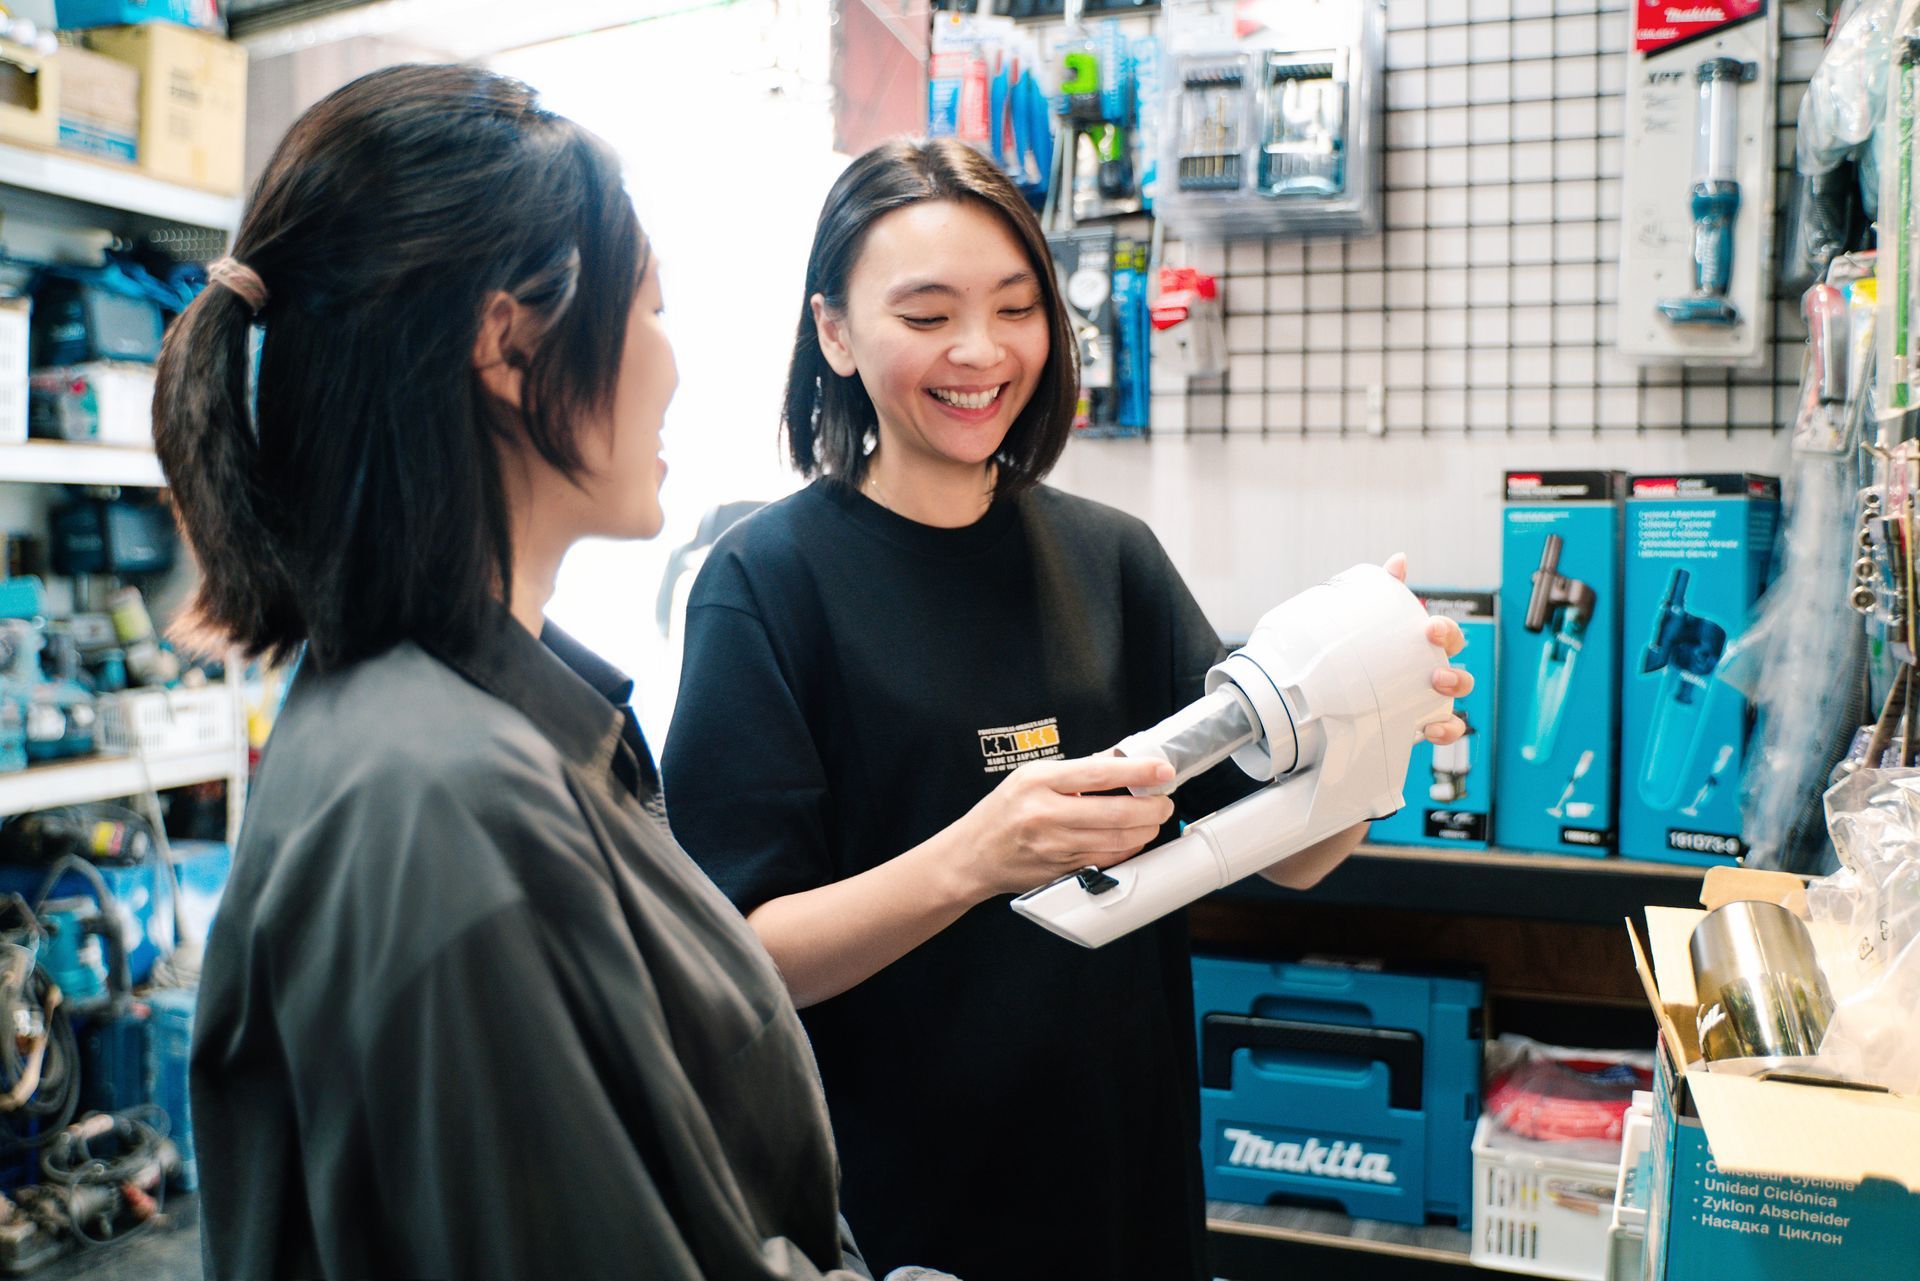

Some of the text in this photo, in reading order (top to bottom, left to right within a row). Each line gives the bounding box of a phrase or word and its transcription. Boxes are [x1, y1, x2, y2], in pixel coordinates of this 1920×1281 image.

[986, 756, 1006, 766] MADE
[1006, 755, 1016, 763] IN
[1016, 751, 1040, 762] JAPAN
[1040, 746, 1059, 757] 1997
[1704, 1178, 1838, 1208] Unidad Ciclónica
[1702, 1196, 1851, 1228] Zyklon Abscheider
[1701, 1214, 1844, 1246] Насадка Циклон
